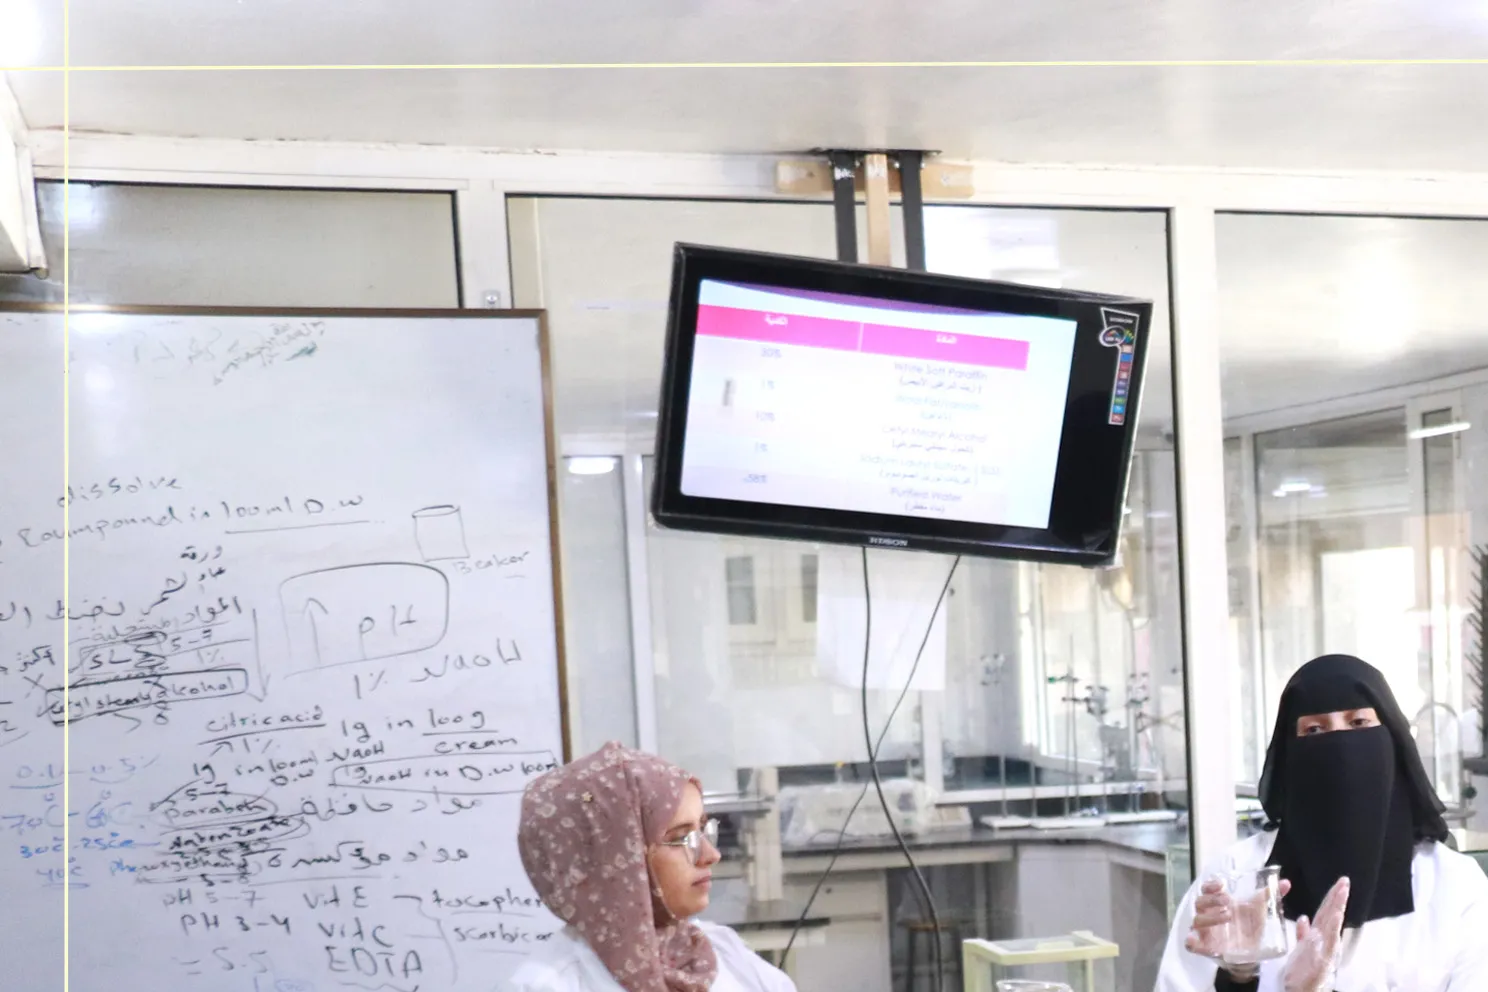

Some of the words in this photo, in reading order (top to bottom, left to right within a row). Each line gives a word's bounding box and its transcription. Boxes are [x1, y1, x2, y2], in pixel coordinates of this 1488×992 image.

[56, 476, 183, 509] dissolve
[931, 490, 963, 502] Water
[324, 945, 423, 979] EDTA
